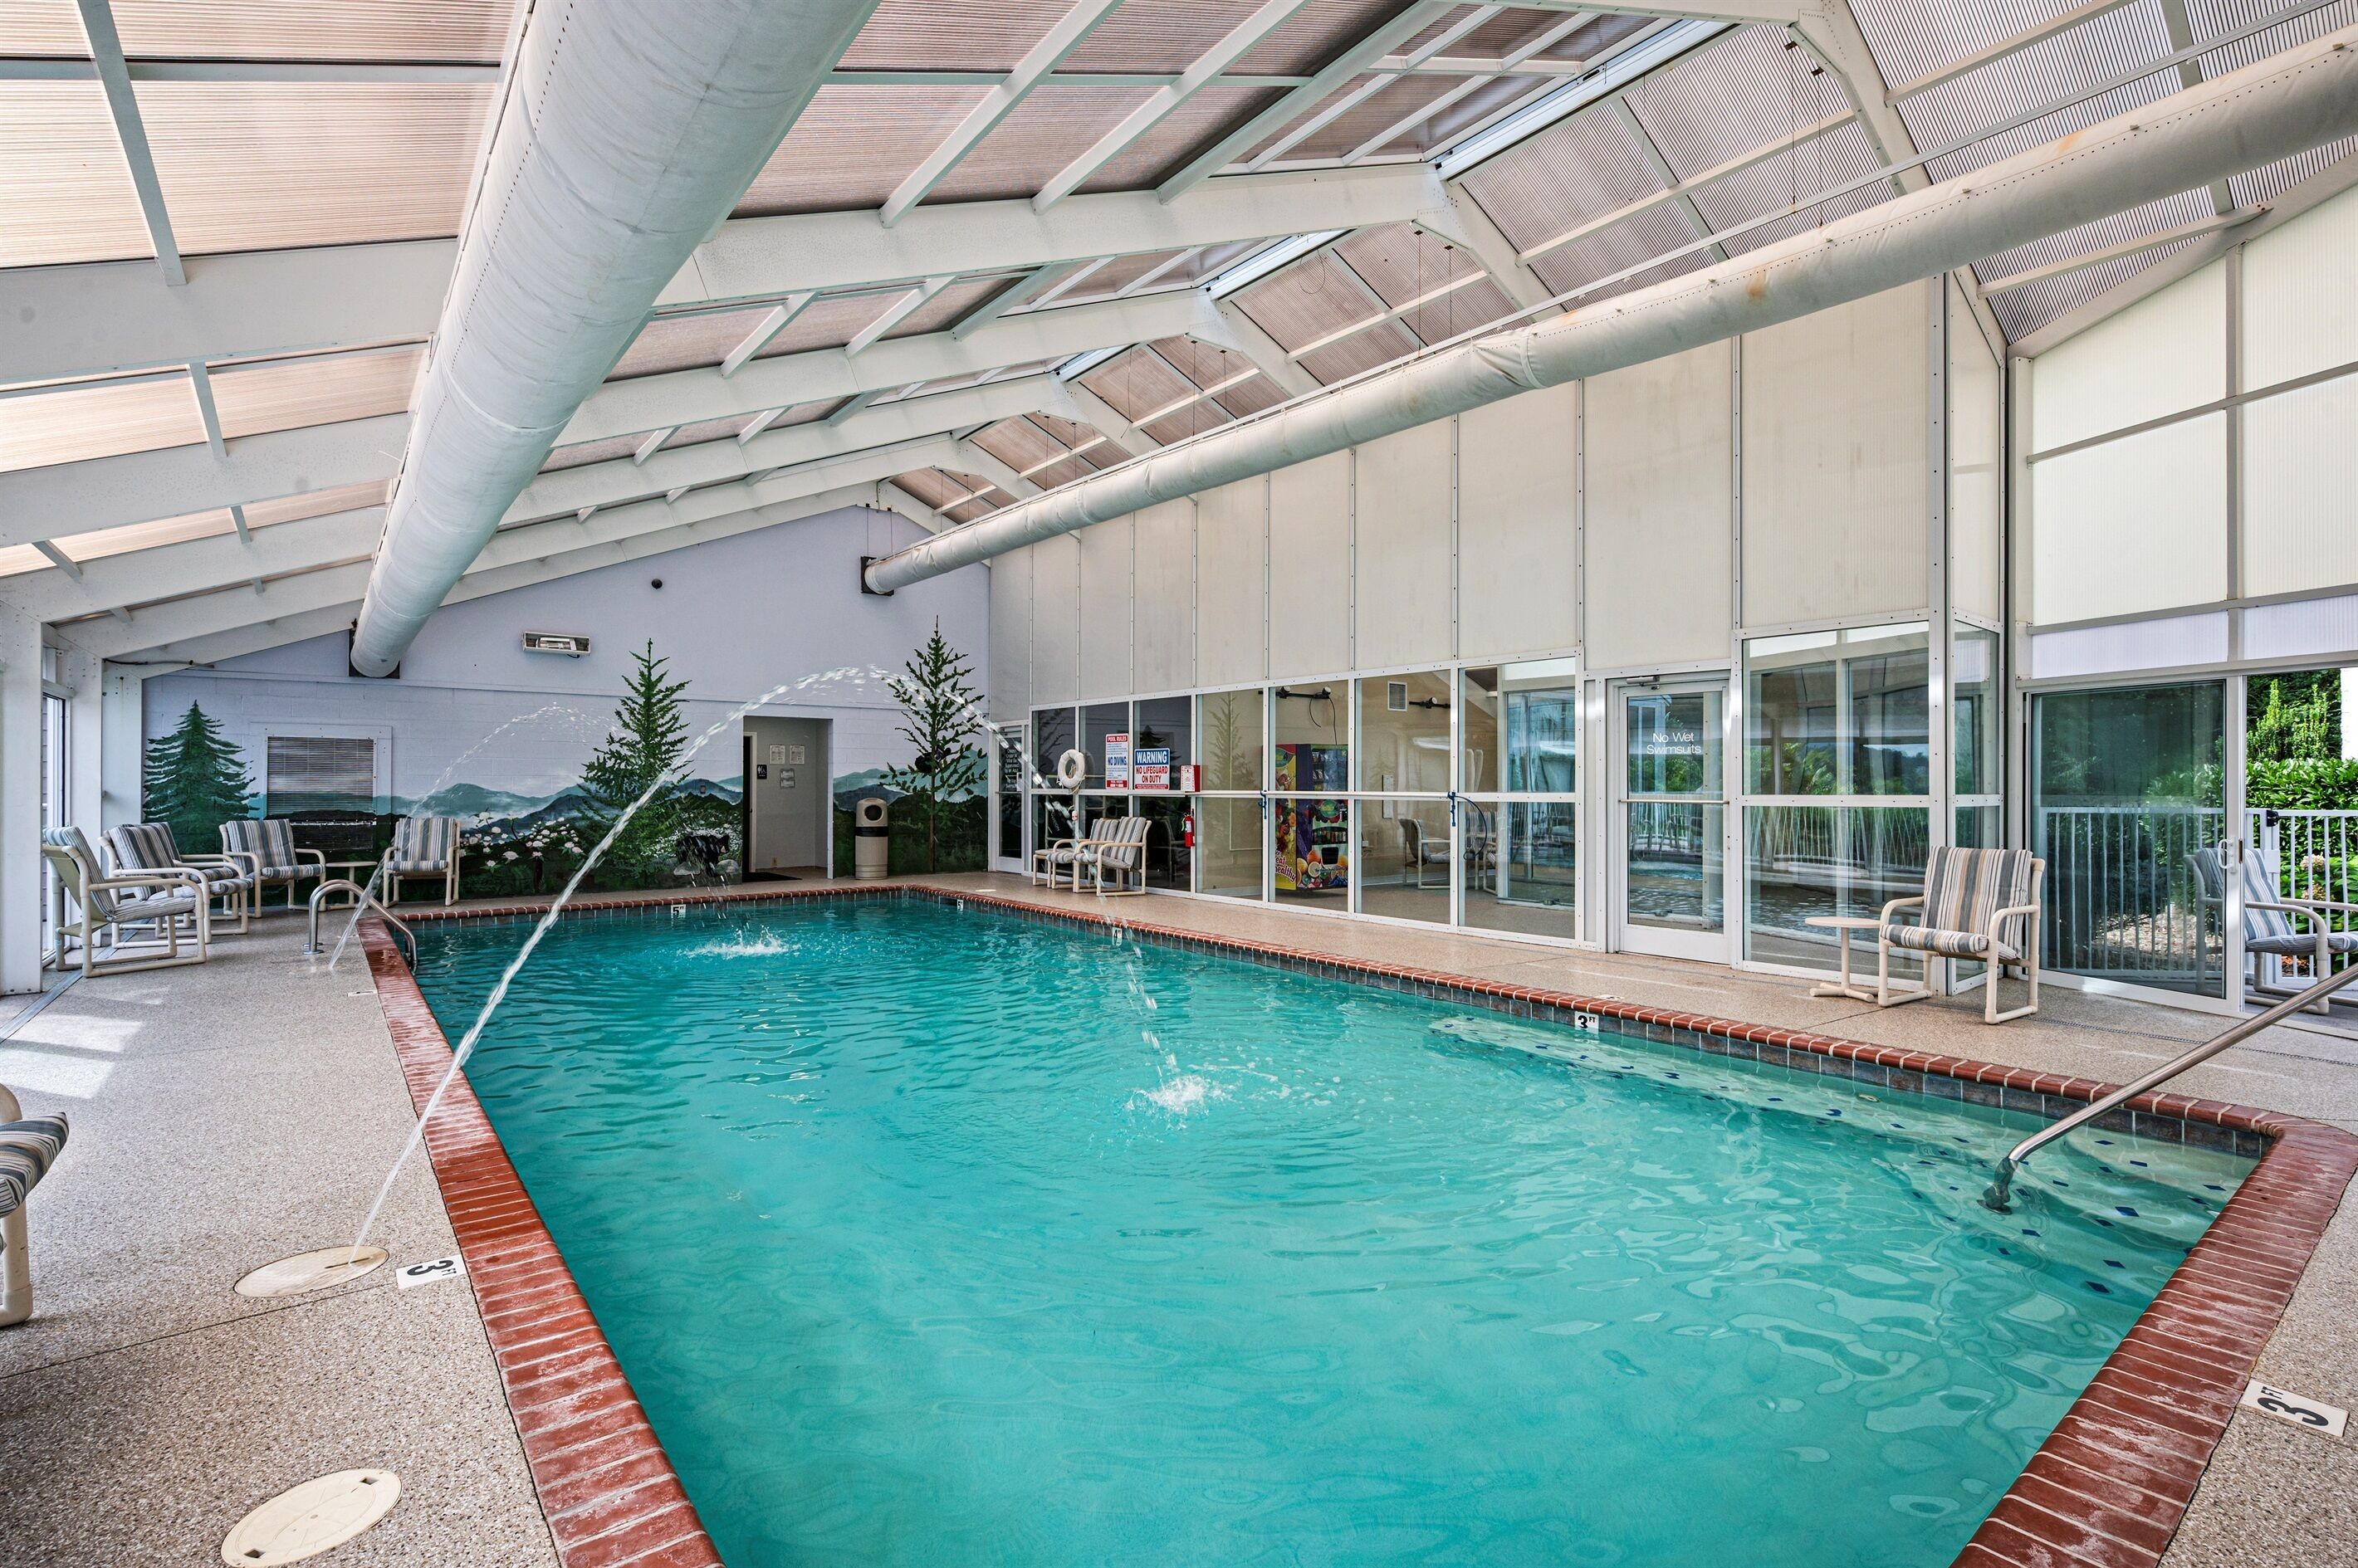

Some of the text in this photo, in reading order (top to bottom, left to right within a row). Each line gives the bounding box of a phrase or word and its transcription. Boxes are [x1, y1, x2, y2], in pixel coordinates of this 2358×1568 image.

[1653, 732, 1694, 742] No Wet
[1646, 744, 1701, 755] Swimsuits
[1108, 756, 1113, 765] NO
[1136, 750, 1167, 764] WARNING
[1275, 856, 1286, 864] eat
[673, 906, 679, 916] 5
[1578, 1015, 1588, 1029] 3
[407, 1260, 457, 1277] 3 FT
[2257, 1385, 2329, 1427] 3 FT
